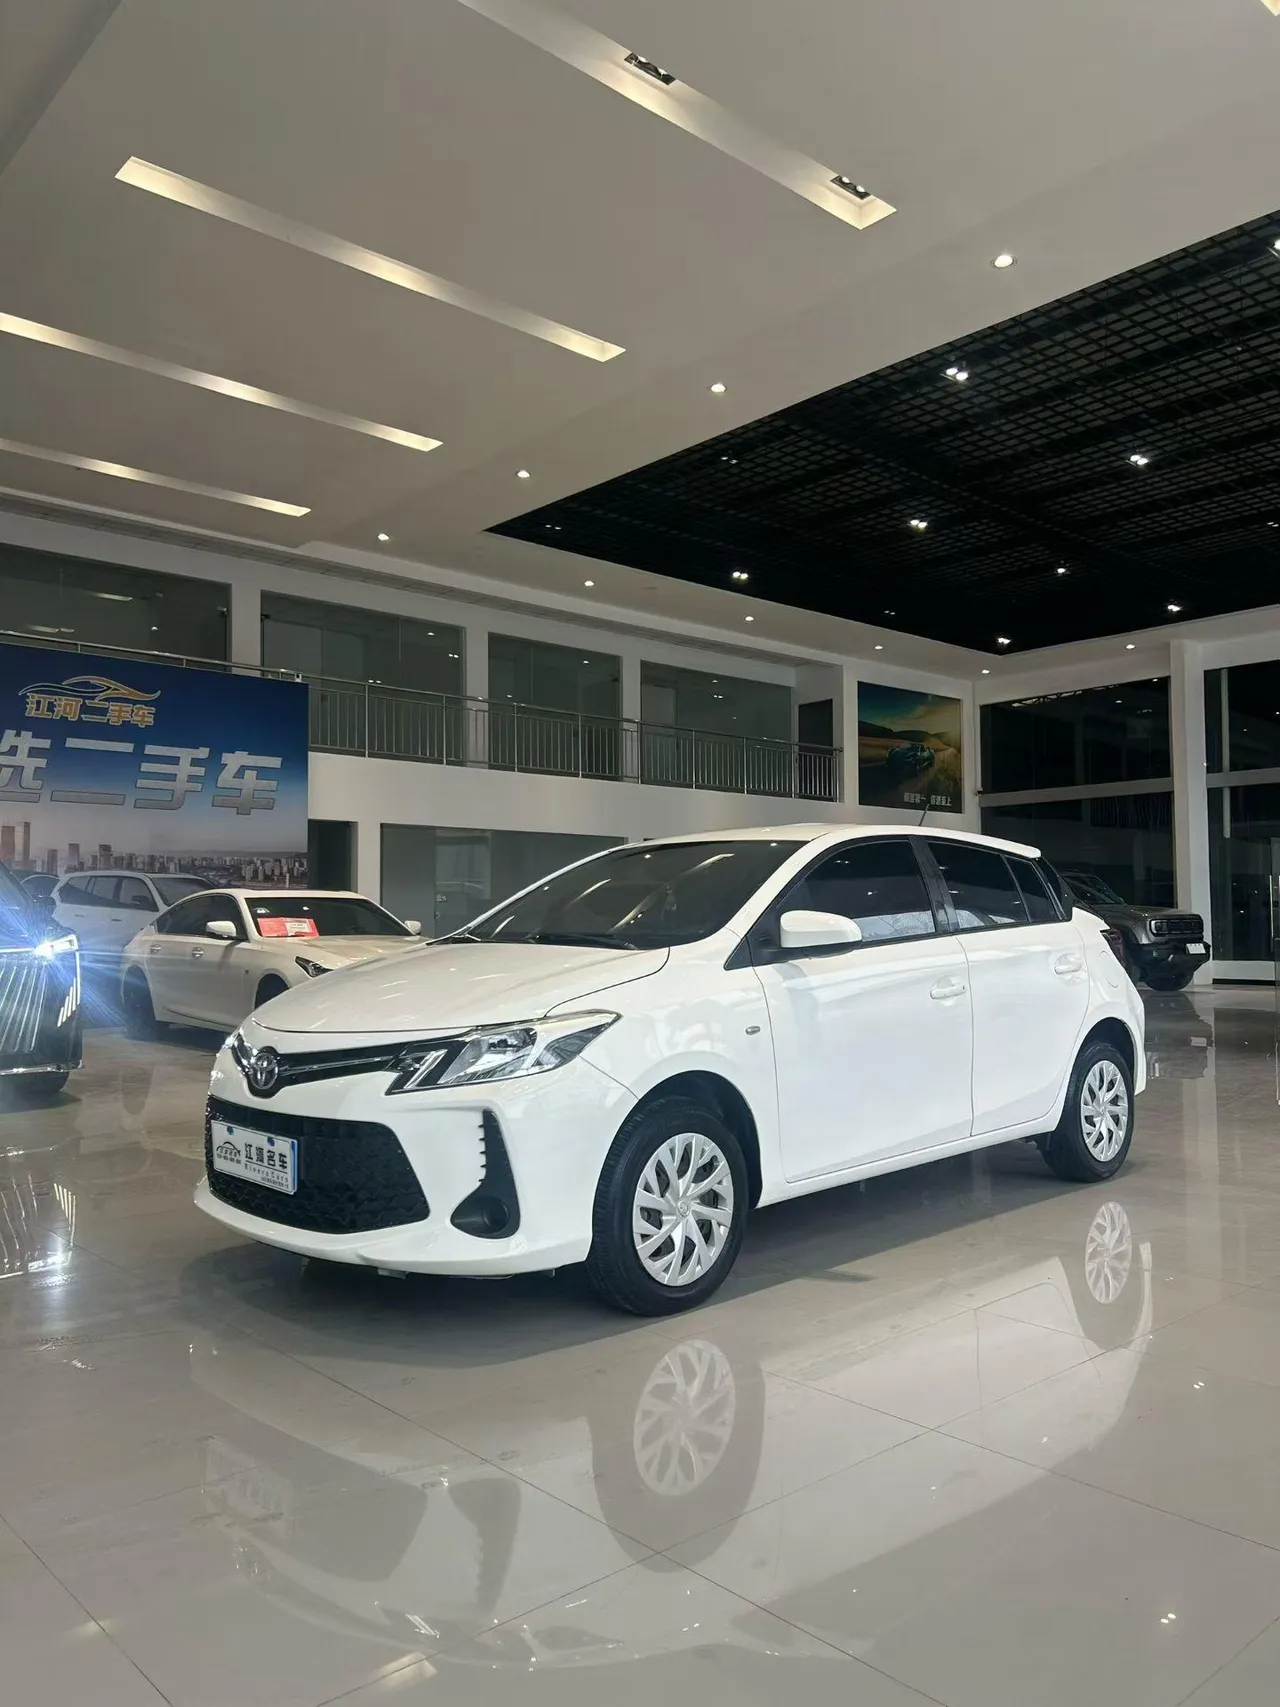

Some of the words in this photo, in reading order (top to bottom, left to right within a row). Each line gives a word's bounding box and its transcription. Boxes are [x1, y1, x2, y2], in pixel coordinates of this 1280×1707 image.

[25, 693, 156, 728] 江河二手车
